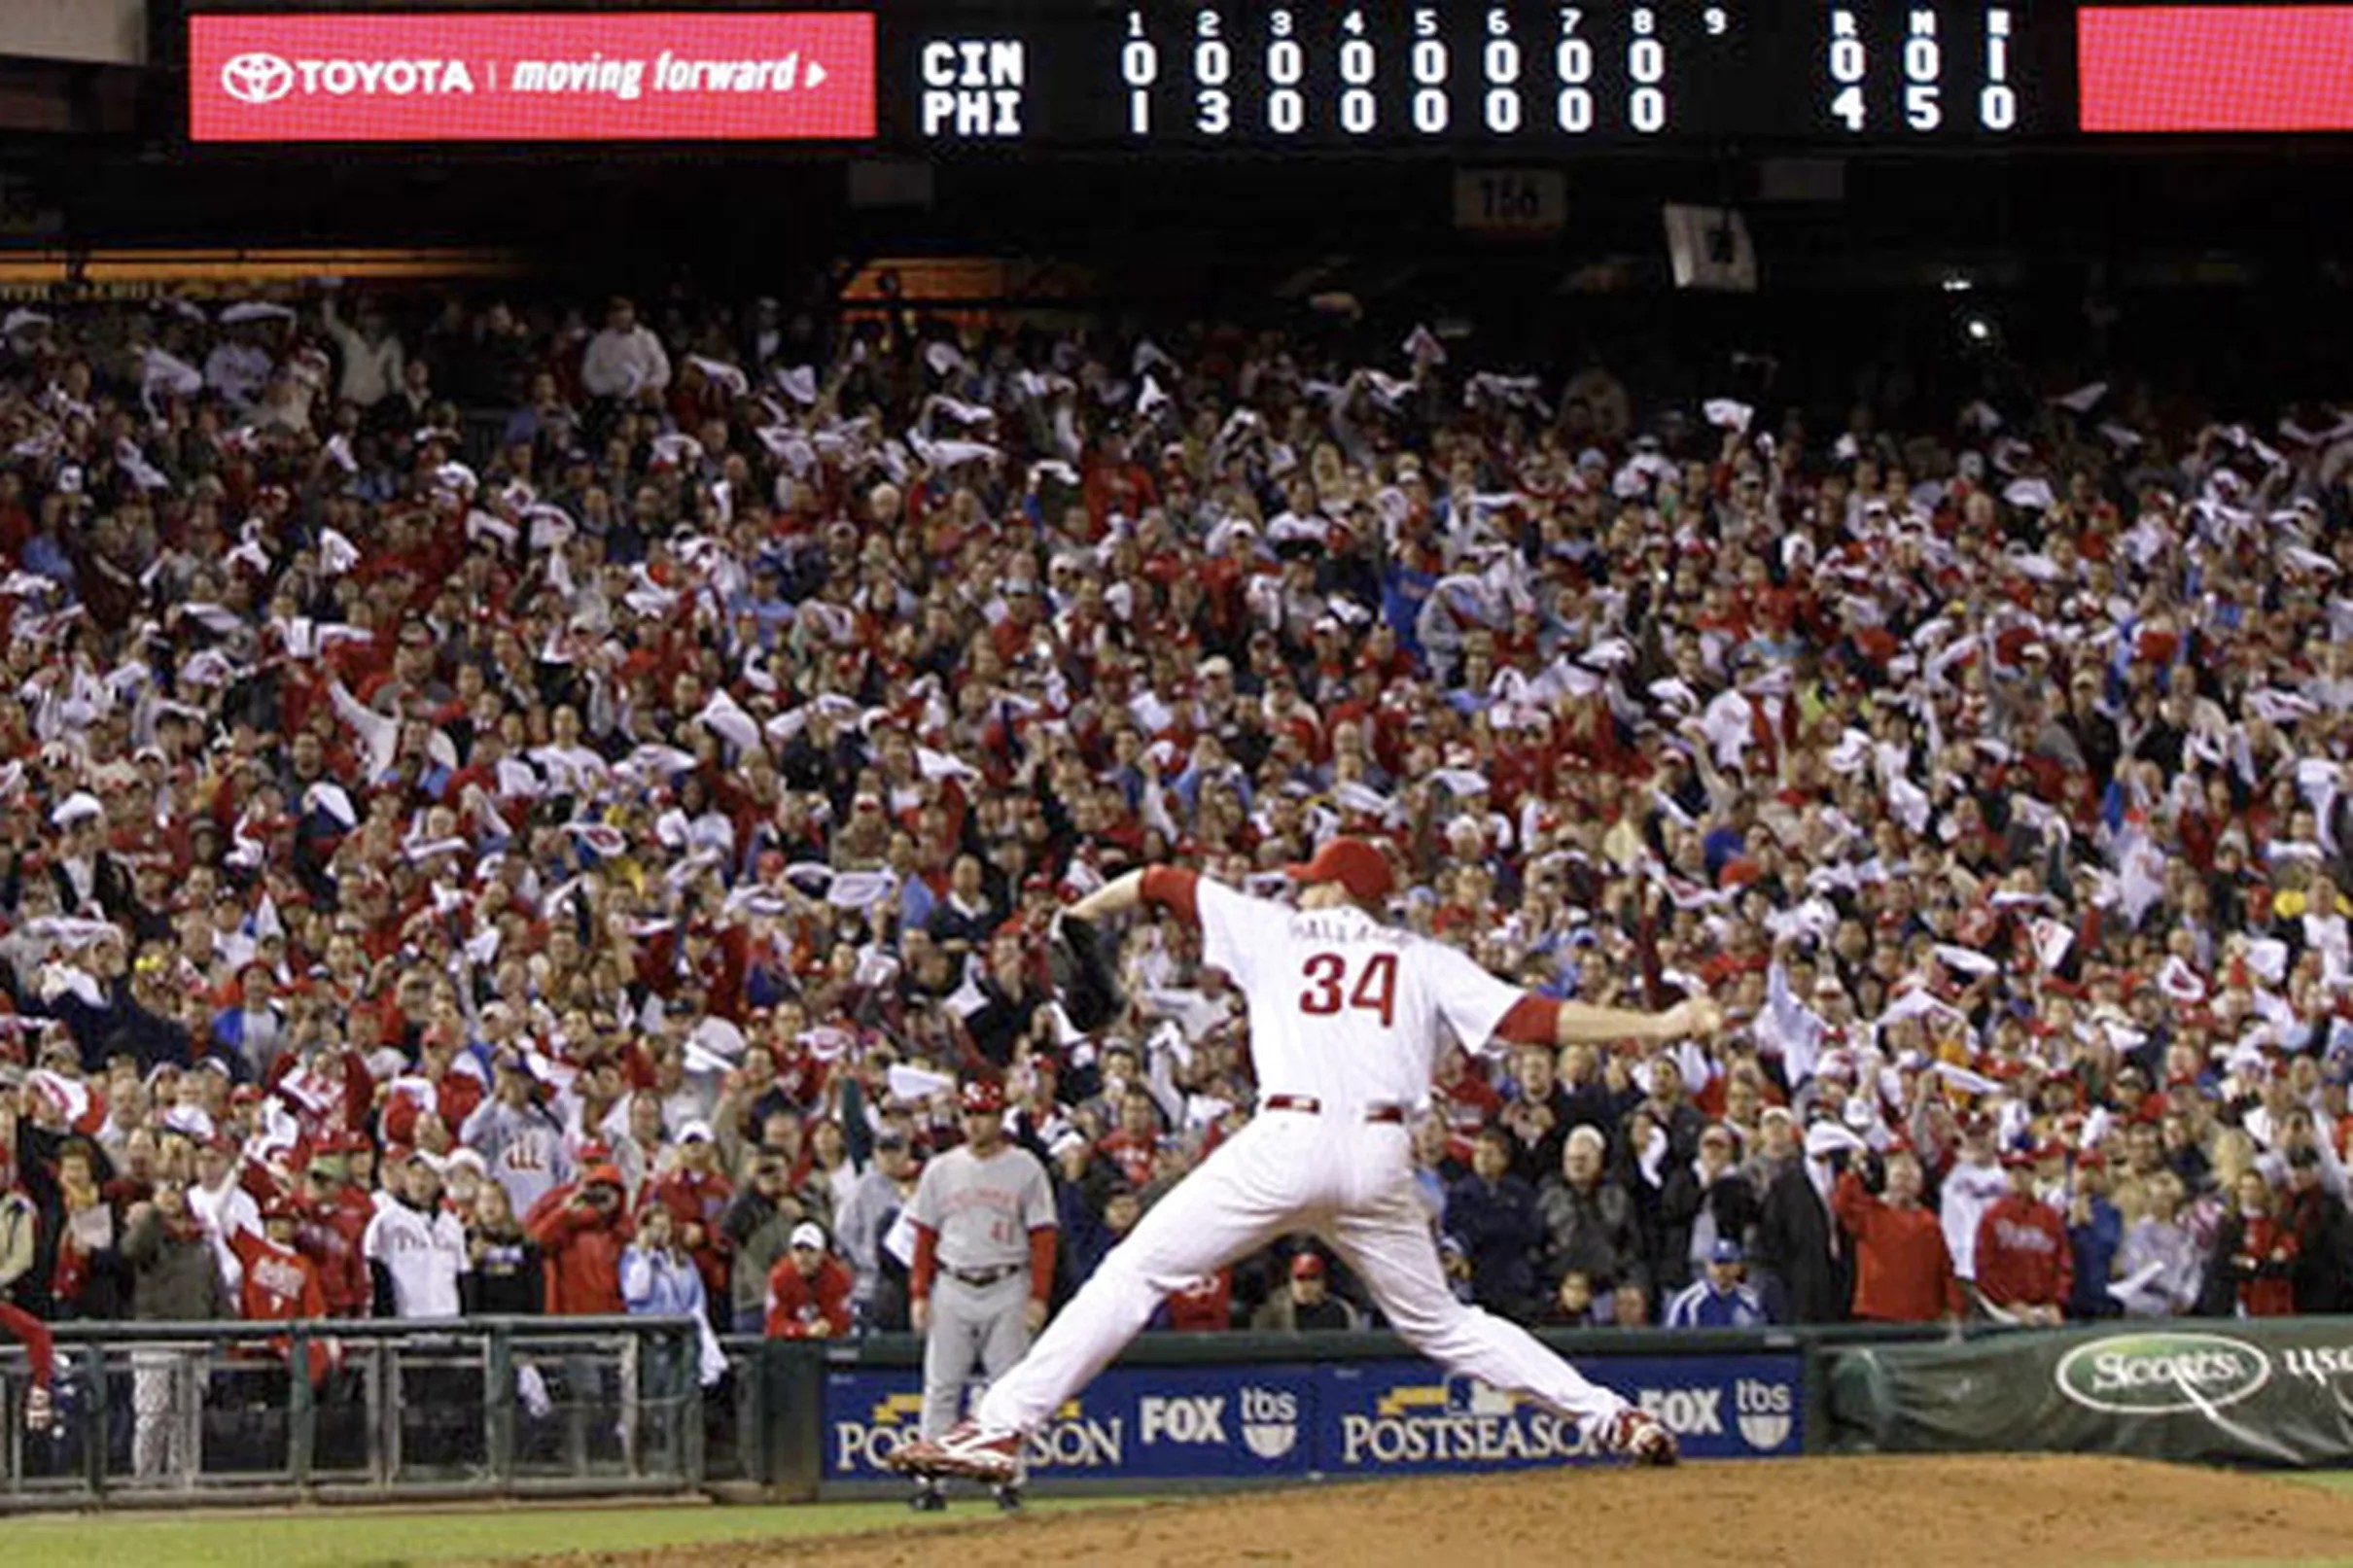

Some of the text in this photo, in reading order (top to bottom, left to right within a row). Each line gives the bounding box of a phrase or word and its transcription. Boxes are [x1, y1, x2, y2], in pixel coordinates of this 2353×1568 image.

[1129, 11, 1143, 37] 1
[1197, 10, 1221, 37] 2
[1271, 10, 1292, 37] 3
[1343, 10, 1364, 36] 4
[1415, 9, 1438, 37] 5
[1487, 9, 1510, 36] 6
[1561, 8, 1582, 35] 7
[1632, 8, 1654, 35] 8
[1703, 8, 1727, 35] 9
[297, 50, 798, 100] TOYOTA moving forward
[923, 38, 2007, 87] CIN 0 0 0 0 0 0 0 0 0 0 1
[923, 85, 2016, 136] PHI 1 3 0 0 0 0 0 0 4 5 0
[1299, 952, 1399, 1028] 34
[1241, 1386, 1296, 1421] tbs
[1638, 1387, 1723, 1435] FOX
[1736, 1377, 1791, 1412] tbs
[1141, 1397, 1225, 1444] FOX
[1343, 1415, 1599, 1462] POSTSEASO
[835, 1418, 1122, 1472] POSSON
